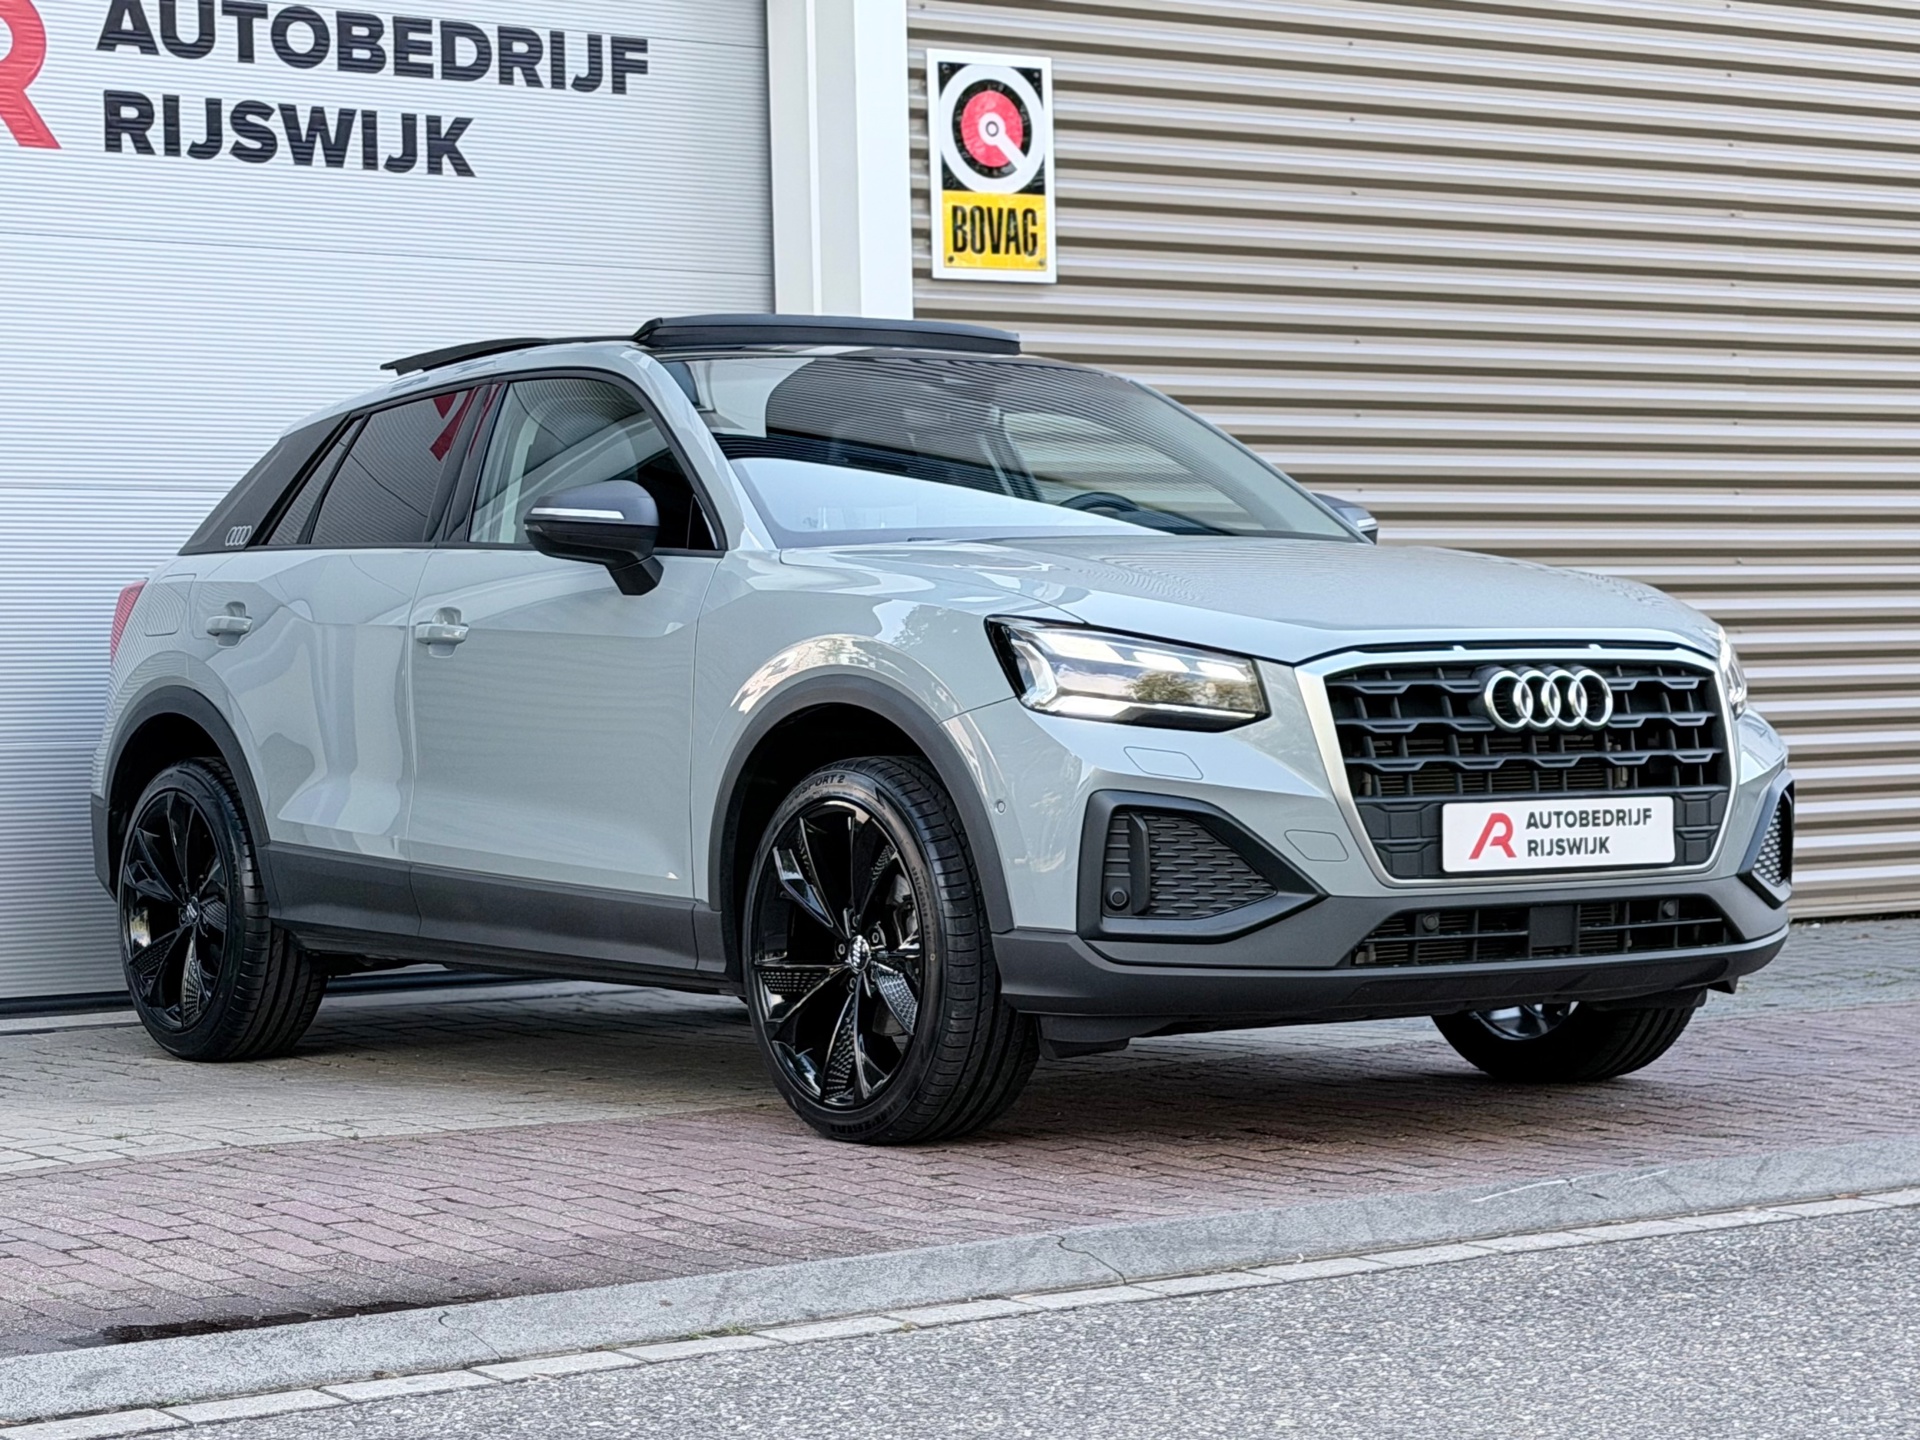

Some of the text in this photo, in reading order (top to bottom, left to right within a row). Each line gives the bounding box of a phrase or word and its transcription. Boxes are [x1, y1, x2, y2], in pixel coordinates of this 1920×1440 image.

[97, 0, 649, 95] AUTOBEDRIJF
[103, 90, 476, 178] RIJSWIJK
[951, 205, 1038, 257] BOVAG
[1526, 808, 1652, 829] AUTOBEDRIJF
[1527, 836, 1610, 857] RIJSWIJK
